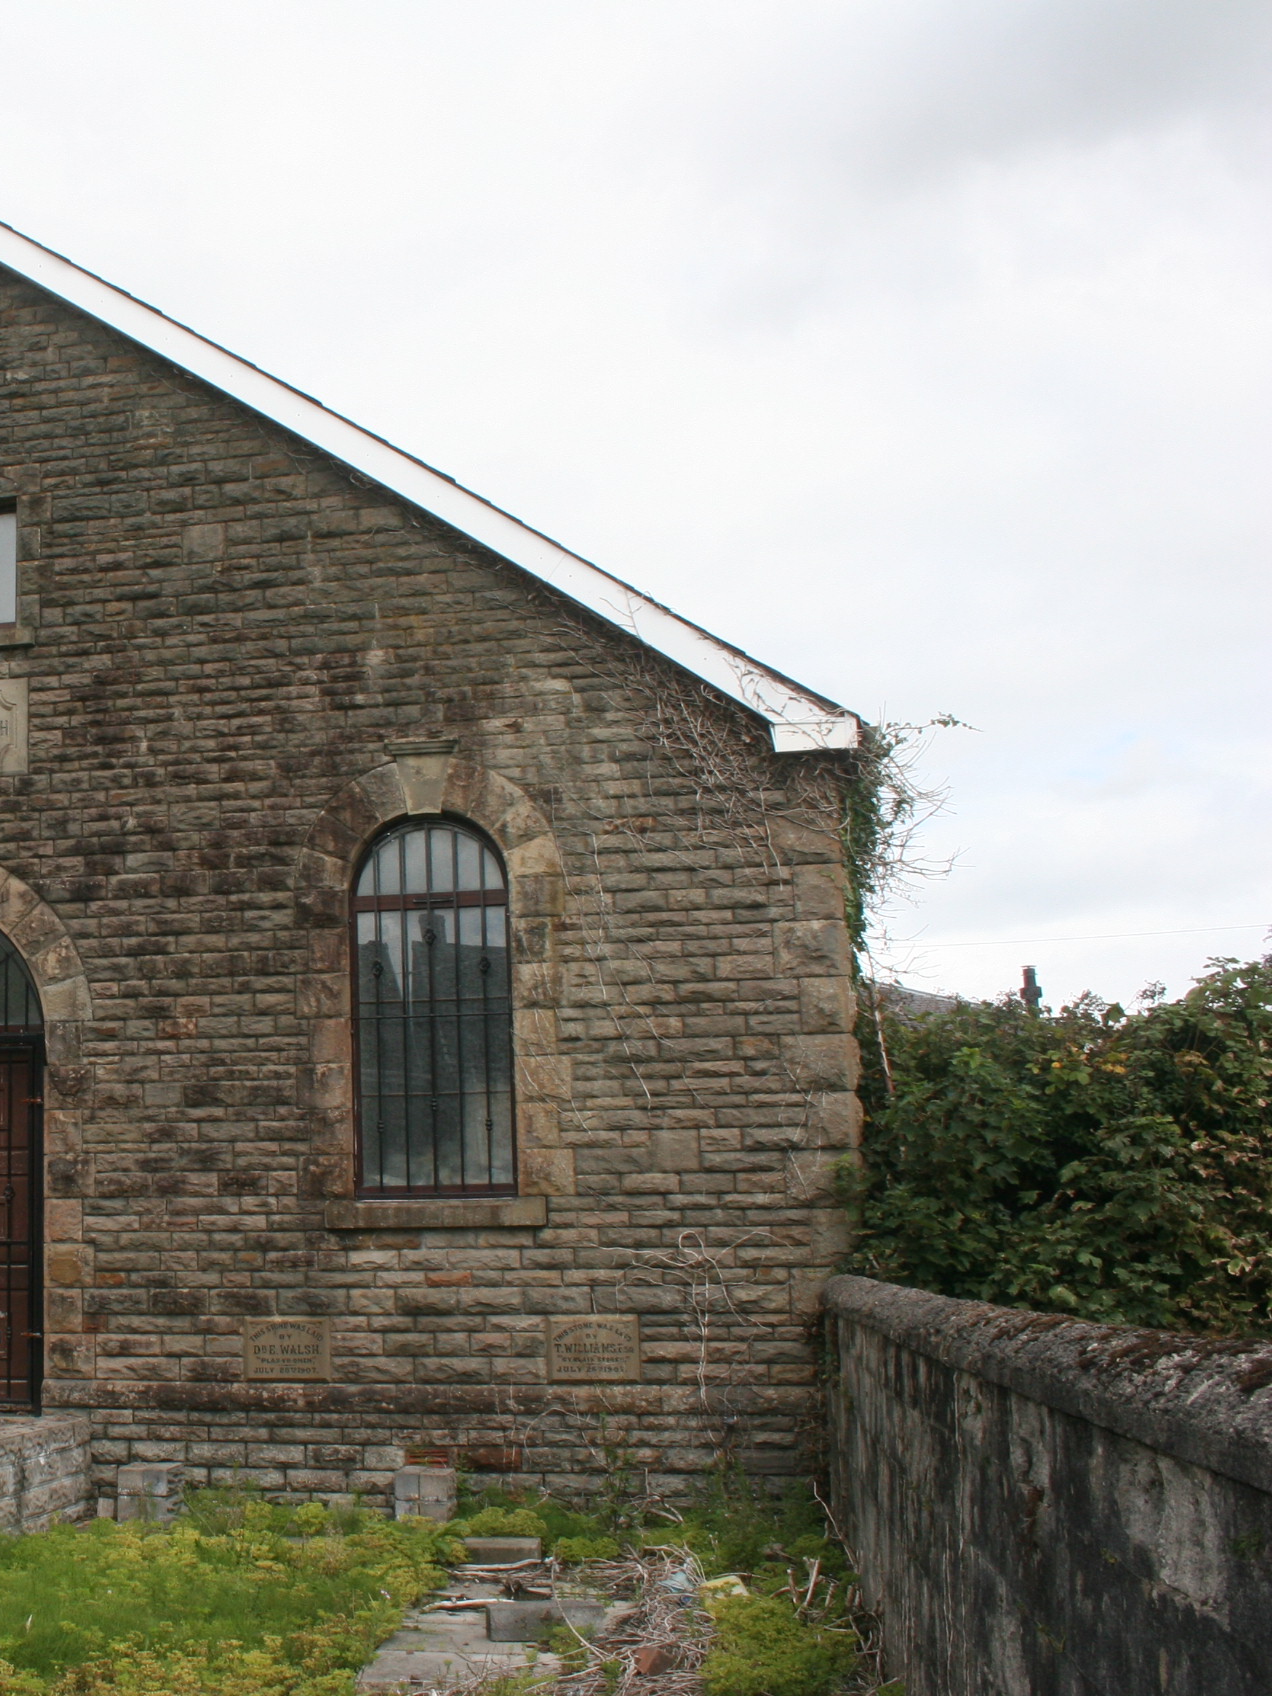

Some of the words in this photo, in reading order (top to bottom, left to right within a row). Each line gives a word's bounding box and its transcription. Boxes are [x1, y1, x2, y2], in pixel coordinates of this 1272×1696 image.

[249, 1328, 266, 1342] THIS
[265, 1322, 288, 1332] STONE
[289, 1323, 306, 1332] WAS
[306, 1327, 324, 1342] LAID
[553, 1329, 568, 1342] THIS
[568, 1322, 593, 1333] STONE
